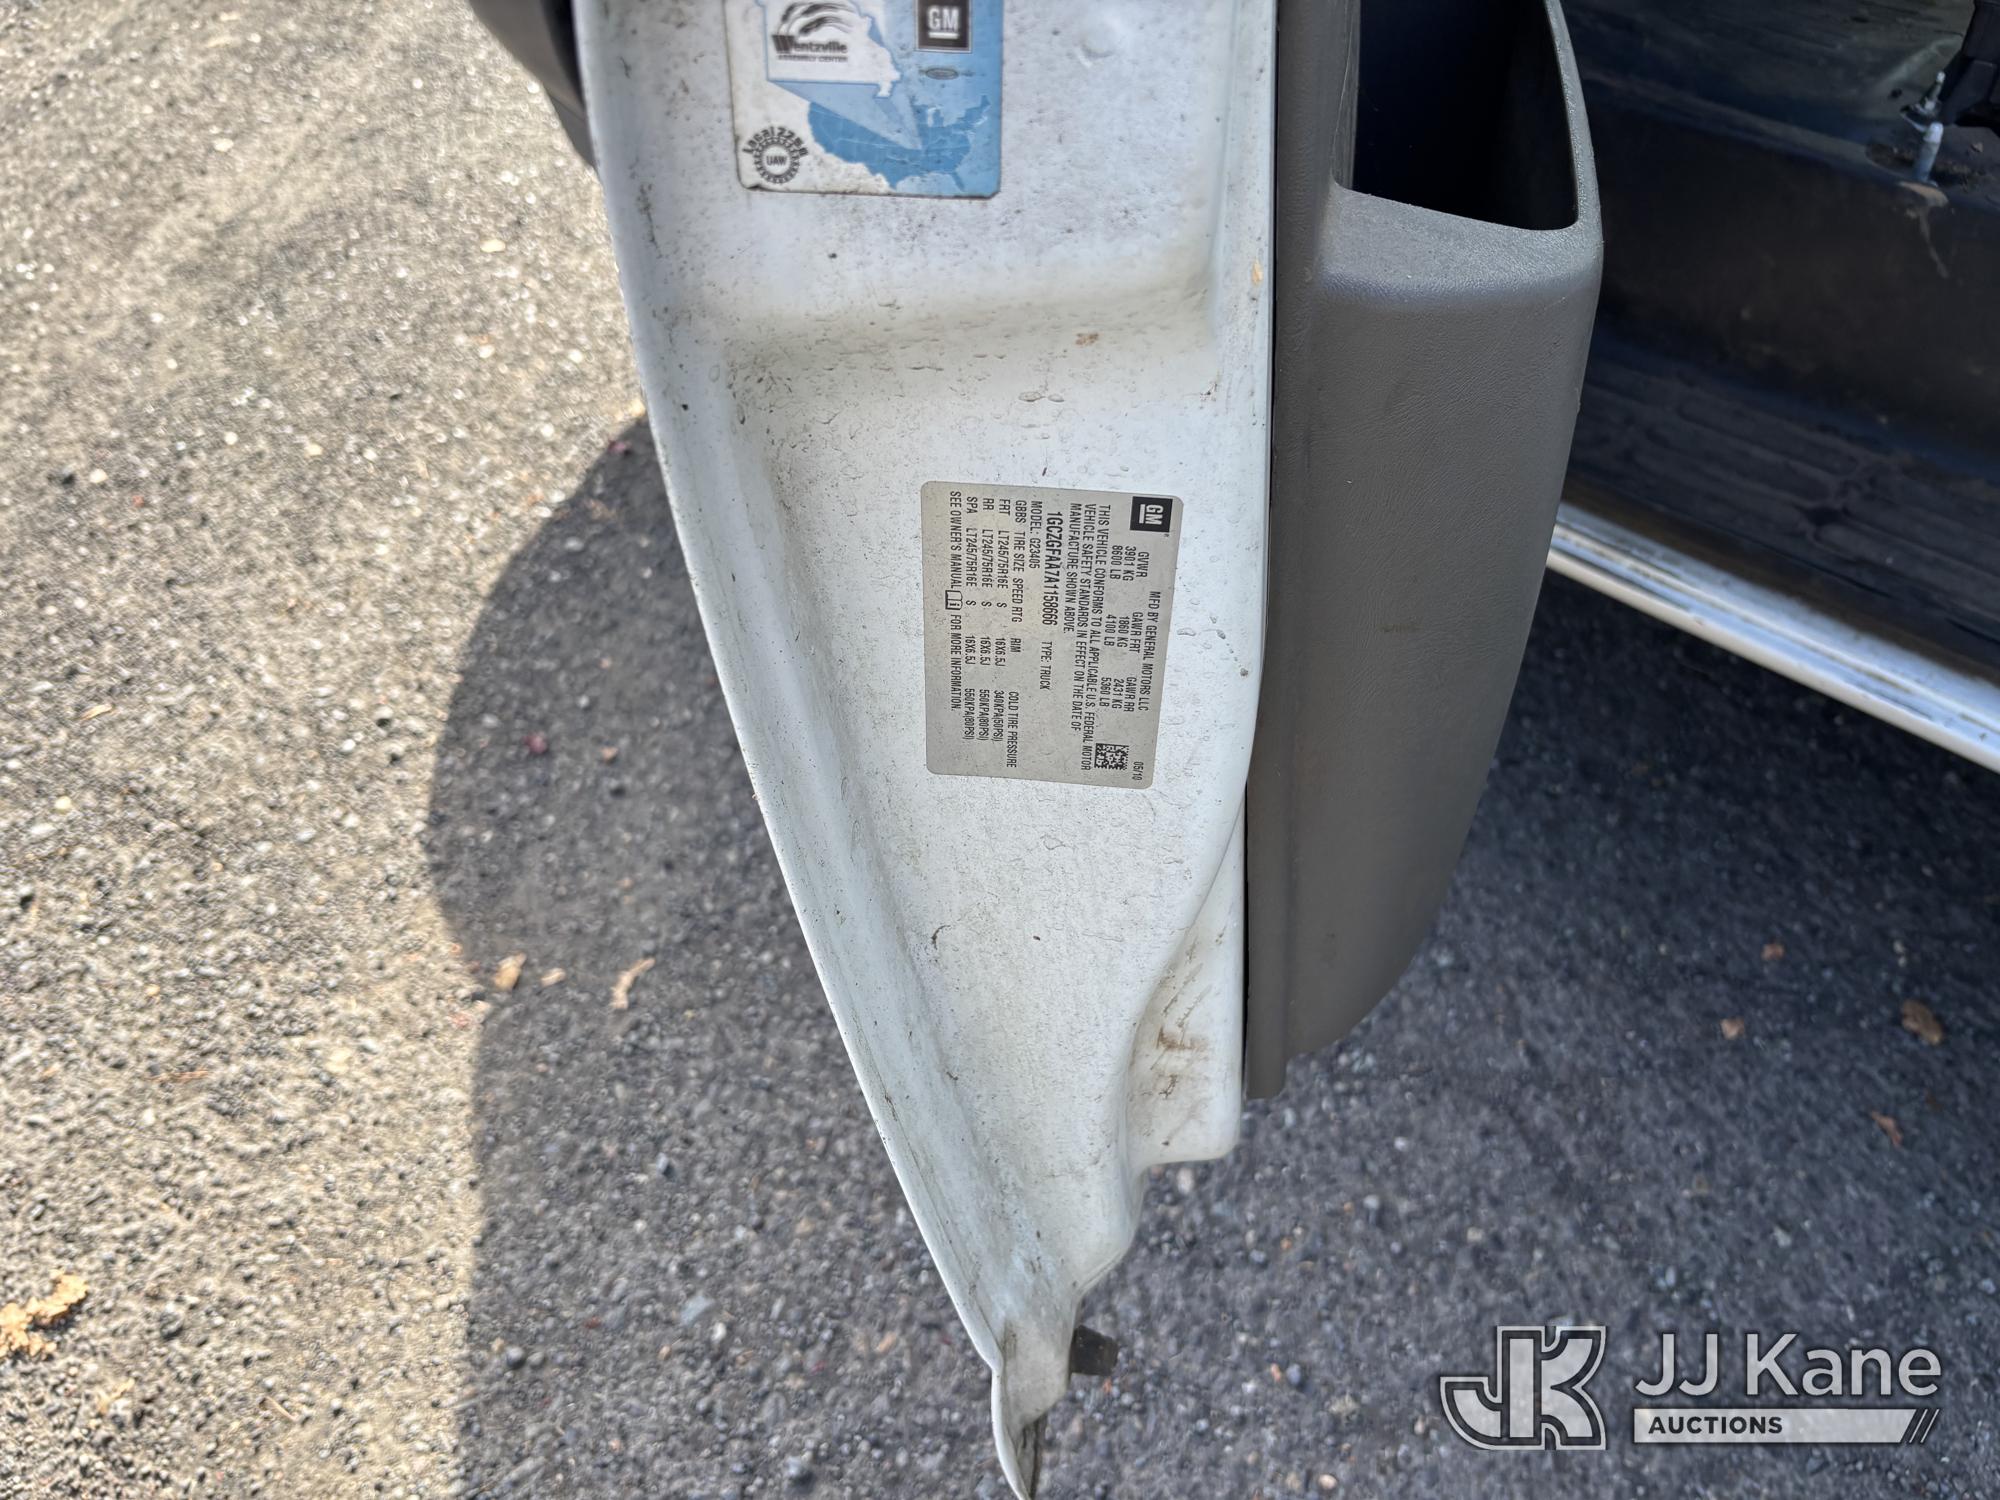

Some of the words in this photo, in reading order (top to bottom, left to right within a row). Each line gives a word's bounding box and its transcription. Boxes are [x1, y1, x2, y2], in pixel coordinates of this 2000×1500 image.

[928, 5, 959, 32] GM
[950, 491, 961, 508] SEE
[967, 497, 977, 514] SPA
[983, 498, 994, 510] RR
[999, 499, 1010, 515] FRT
[1030, 500, 1042, 534] MODEL:
[1083, 504, 1096, 541] VEHICLE
[1098, 505, 1110, 525] THIS
[1145, 504, 1164, 525] GM
[950, 510, 961, 551] OWNER'S
[1067, 503, 1081, 569] MANUFACTURE
[1014, 532, 1025, 550] TIRE
[1095, 528, 1109, 565] VEHICLE
[966, 528, 977, 587] LT245/75R16E
[982, 529, 993, 587] LT245/75R16E
[998, 530, 1009, 589] LT245/75R16E
[1013, 553, 1025, 572] SIZE
[1029, 538, 1041, 568] G23405
[1081, 544, 1093, 575] SAFETY
[1111, 545, 1123, 565] 8600
[1124, 546, 1136, 566] 3901
[951, 554, 961, 588] MANUAL
[1042, 512, 1063, 625] 1GCZGFAA7A1158666
[1110, 569, 1121, 579] LB
[1136, 552, 1149, 577] GVWR
[1123, 570, 1134, 581] KG
[1012, 578, 1023, 604] SPEED
[1065, 572, 1077, 603] SHOWN
[1092, 568, 1105, 614] CONFORMS
[1078, 578, 1090, 627] STANDARDS
[1149, 591, 1161, 609] MFD
[951, 614, 961, 630] FOR
[1012, 606, 1022, 623] RTG
[1063, 606, 1075, 634] ABOVE.
[1090, 617, 1102, 627] TO
[1105, 614, 1116, 633] 4100
[1131, 612, 1143, 636] GAWR
[1147, 612, 1158, 622] BY
[1118, 616, 1129, 634] 1860
[951, 633, 961, 655] MORE
[1010, 638, 1021, 652] RIM
[1090, 629, 1101, 643] ALL
[1104, 637, 1114, 646] LB
[1117, 637, 1128, 647] KG
[1129, 639, 1140, 653] FRT
[1143, 625, 1157, 660] GENERAL
[965, 635, 975, 664] 16X6.5J
[980, 637, 990, 665] 16X6.5J
[995, 638, 1005, 667] 16X6.5J
[1040, 641, 1052, 662] TYPE:
[1075, 641, 1086, 668] EFFECT
[1040, 665, 1051, 689] TRUCK
[1074, 671, 1084, 682] ON
[1086, 647, 1099, 691] APPLICABLE
[1140, 663, 1153, 695] MOTORS
[951, 657, 961, 711] INFORMATION.
[1073, 684, 1083, 698] THE
[1100, 677, 1111, 695] 5360
[1113, 679, 1123, 696] 2431
[1125, 677, 1136, 699] GAWR
[1008, 691, 1019, 710] COLD
[1071, 701, 1082, 719] DATE
[1085, 695, 1096, 709] U.S.
[1099, 698, 1110, 706] LB
[1112, 699, 1122, 709] KG
[1124, 702, 1134, 712] RR
[1139, 698, 1150, 711] LLC
[1008, 713, 1018, 729] TIRE
[1071, 721, 1081, 731] OF
[1083, 712, 1094, 743] FEDERAL
[1007, 731, 1017, 768] PRESSURE
[1081, 746, 1092, 770] MOTOR
